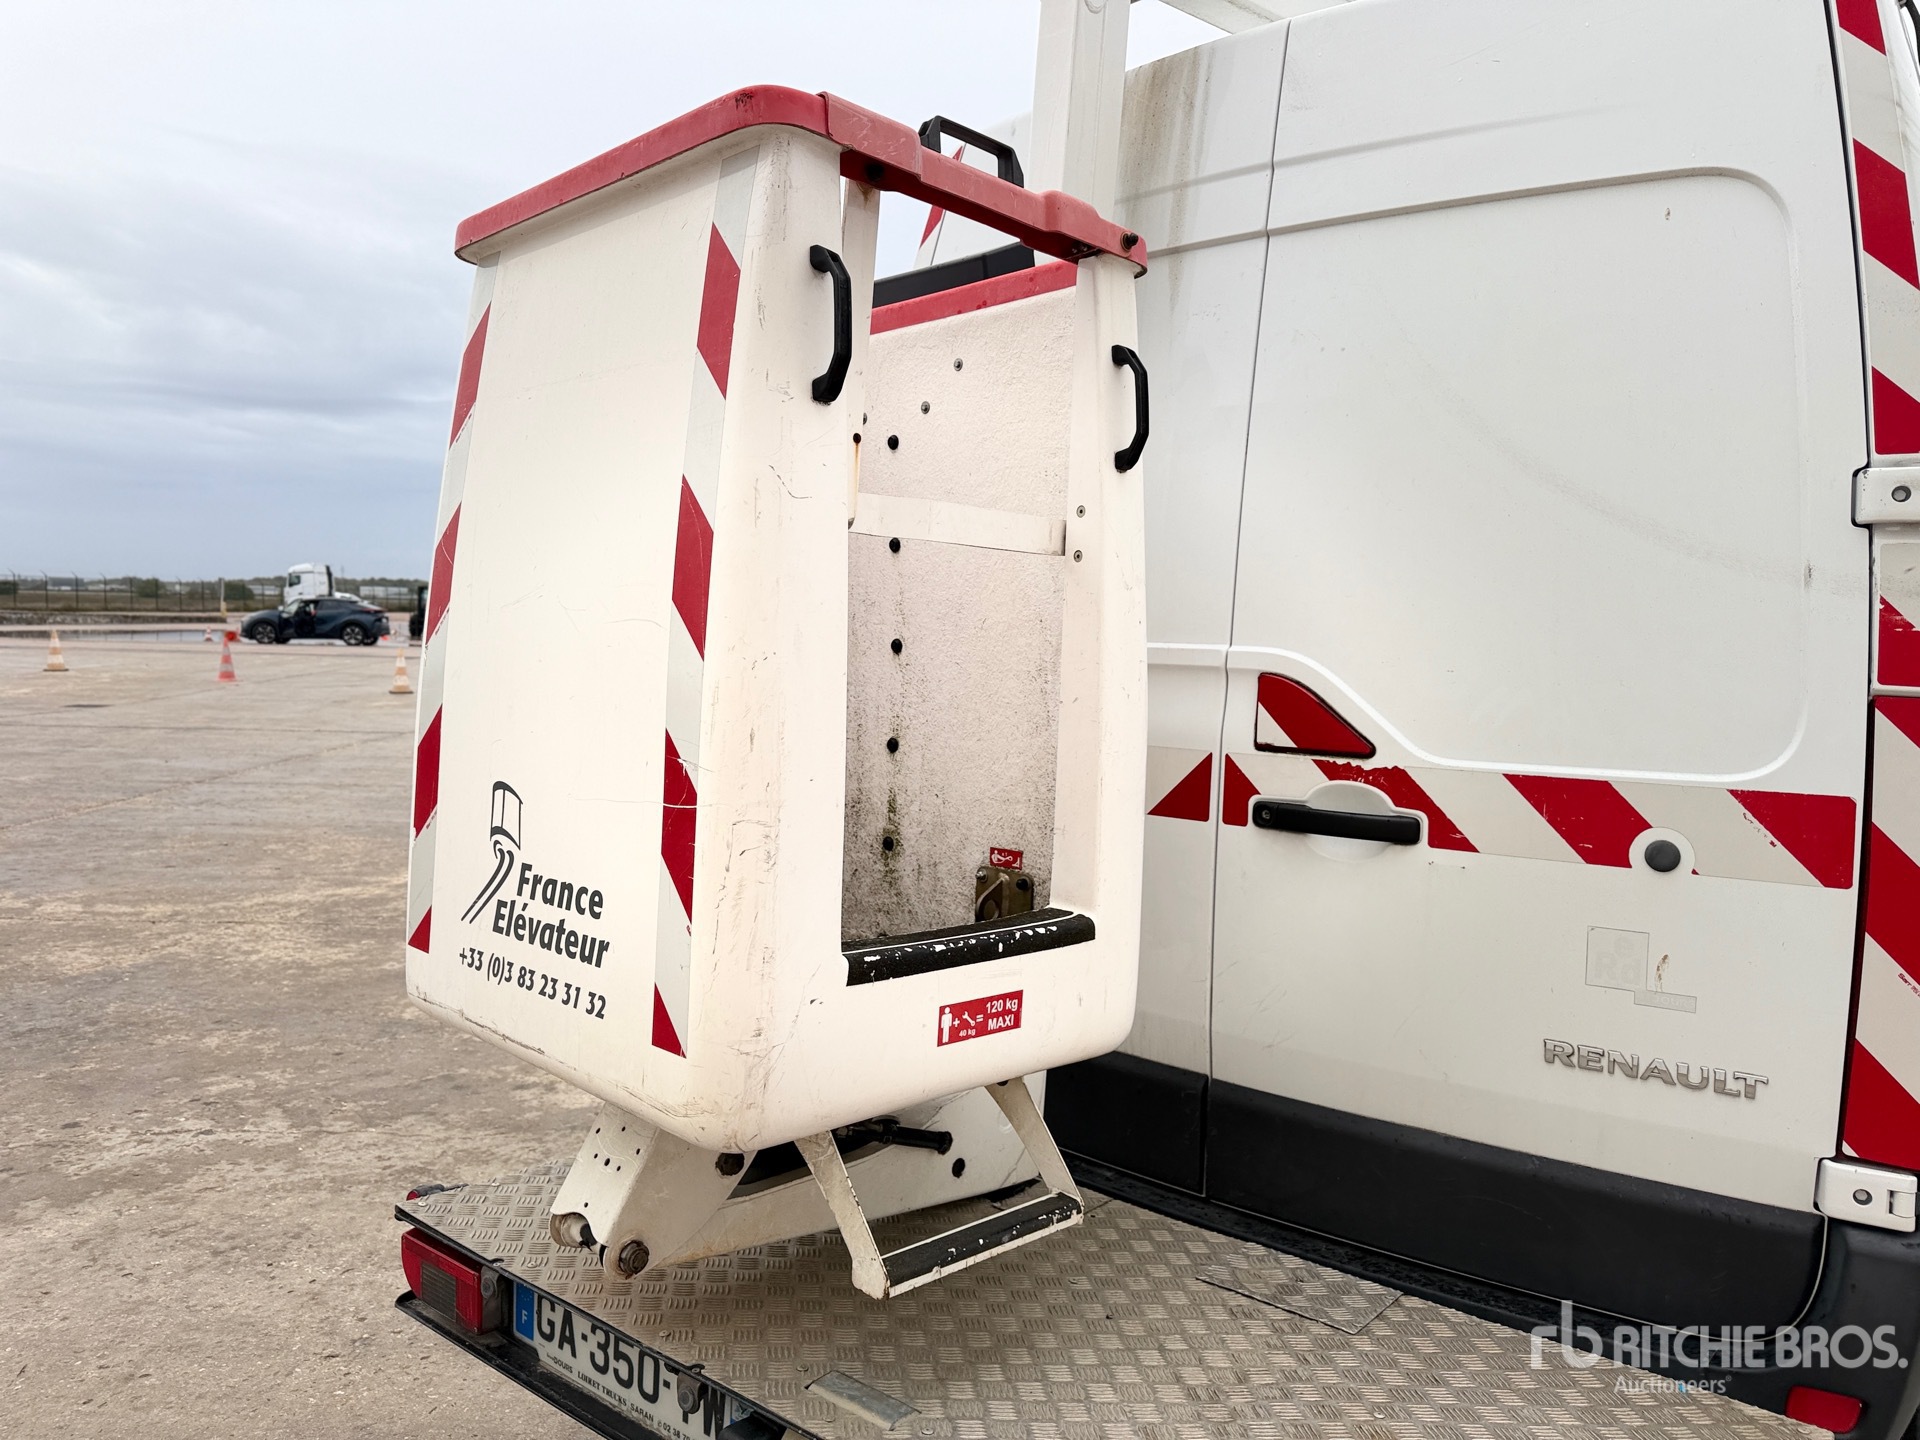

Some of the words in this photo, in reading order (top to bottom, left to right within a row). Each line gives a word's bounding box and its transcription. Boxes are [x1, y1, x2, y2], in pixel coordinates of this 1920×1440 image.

[517, 862, 604, 920] France
[492, 898, 610, 969] Elévateur
[459, 947, 485, 972] +33
[487, 952, 513, 986] (0)3
[517, 966, 536, 992] 83
[538, 973, 559, 1001] 23
[561, 982, 581, 1009] 31
[585, 991, 607, 1020] 32
[986, 999, 1004, 1014] 120
[1005, 998, 1019, 1012] kg
[987, 1014, 1015, 1031] MAXI
[959, 1029, 967, 1037] 40
[967, 1028, 976, 1037] kg
[1543, 1038, 1769, 1100] RENAULT
[521, 1309, 528, 1324] F
[602, 1385, 627, 1407] TRUCKS
[630, 1403, 654, 1422] SARAN
